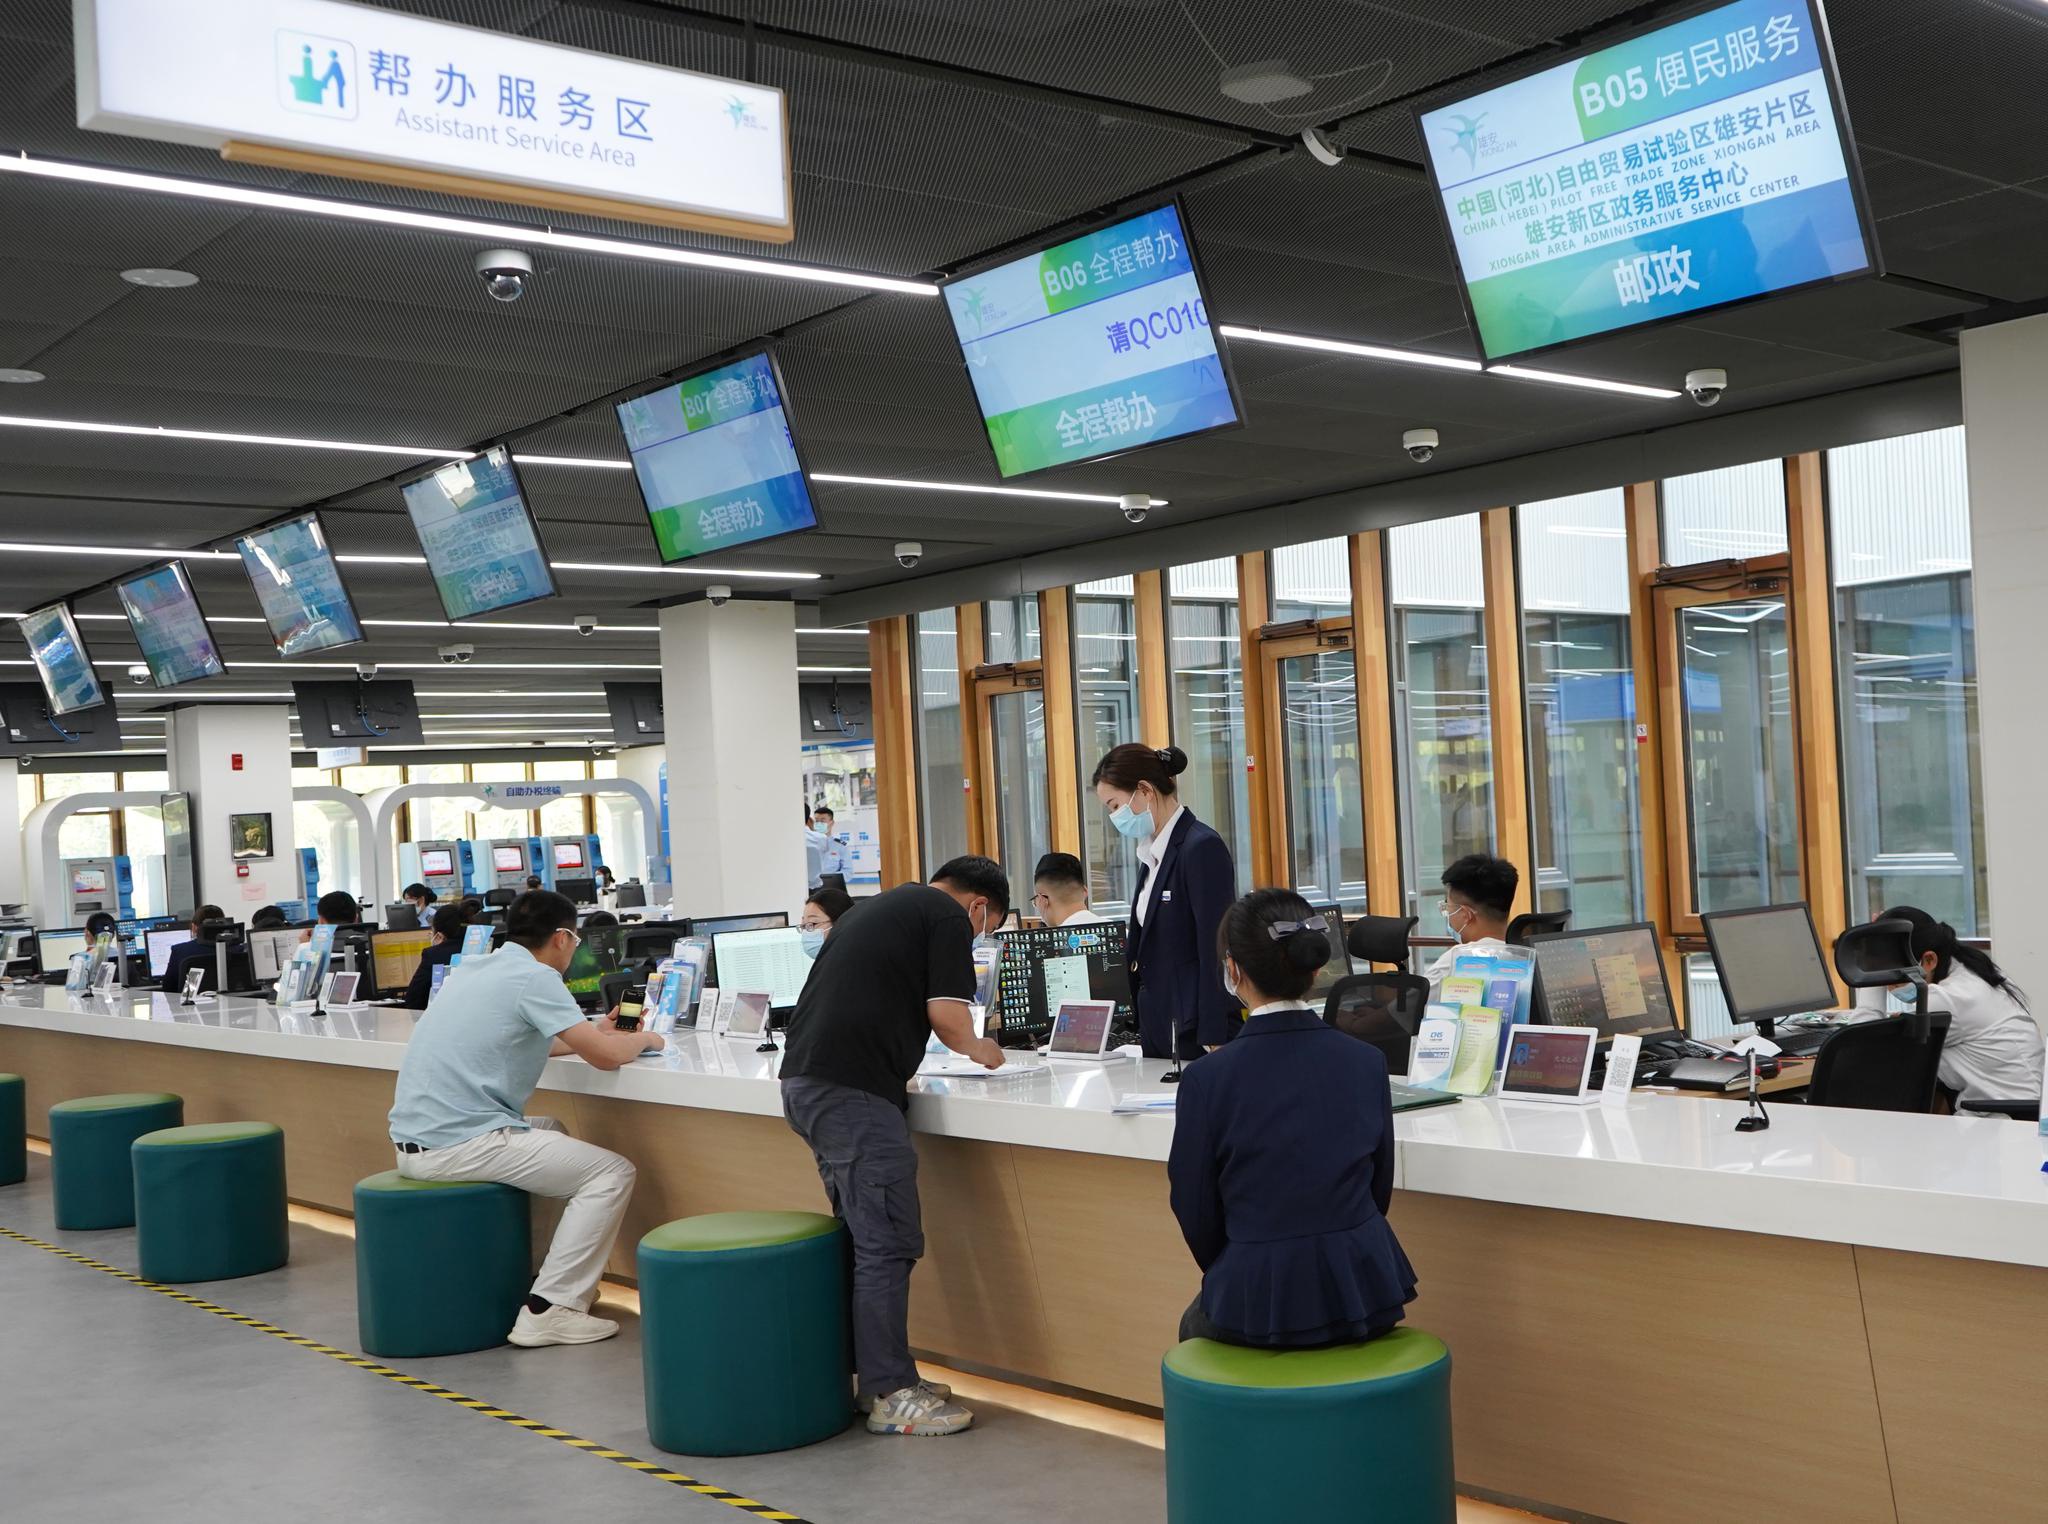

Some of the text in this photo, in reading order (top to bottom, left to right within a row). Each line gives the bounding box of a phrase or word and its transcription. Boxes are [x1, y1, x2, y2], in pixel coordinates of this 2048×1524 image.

[369, 49, 653, 141] 帮办服务区
[1579, 14, 1800, 118] B05 便民服务
[395, 107, 636, 168] Assistant Service Area
[1463, 216, 1498, 236] CHINA
[1551, 191, 1583, 209] PILOT
[1590, 180, 1618, 199] FREE
[1626, 165, 1665, 187] TRADE
[1672, 153, 1707, 174] ZONE
[1714, 132, 1777, 160] XIONGAN
[1786, 119, 1822, 140] AREA
[1525, 161, 1749, 245] 雄安新区政务服务中心
[1489, 175, 1801, 272] XIONGAN AREA ADMINISTRATIVE SERVICE CENTER
[1044, 229, 1179, 296] B06 全程帮办
[1613, 245, 1700, 307] 邮政
[684, 371, 772, 418] B07 全程帮办
[1056, 390, 1157, 448] 全程帮办
[698, 497, 765, 540] 全程帮办
